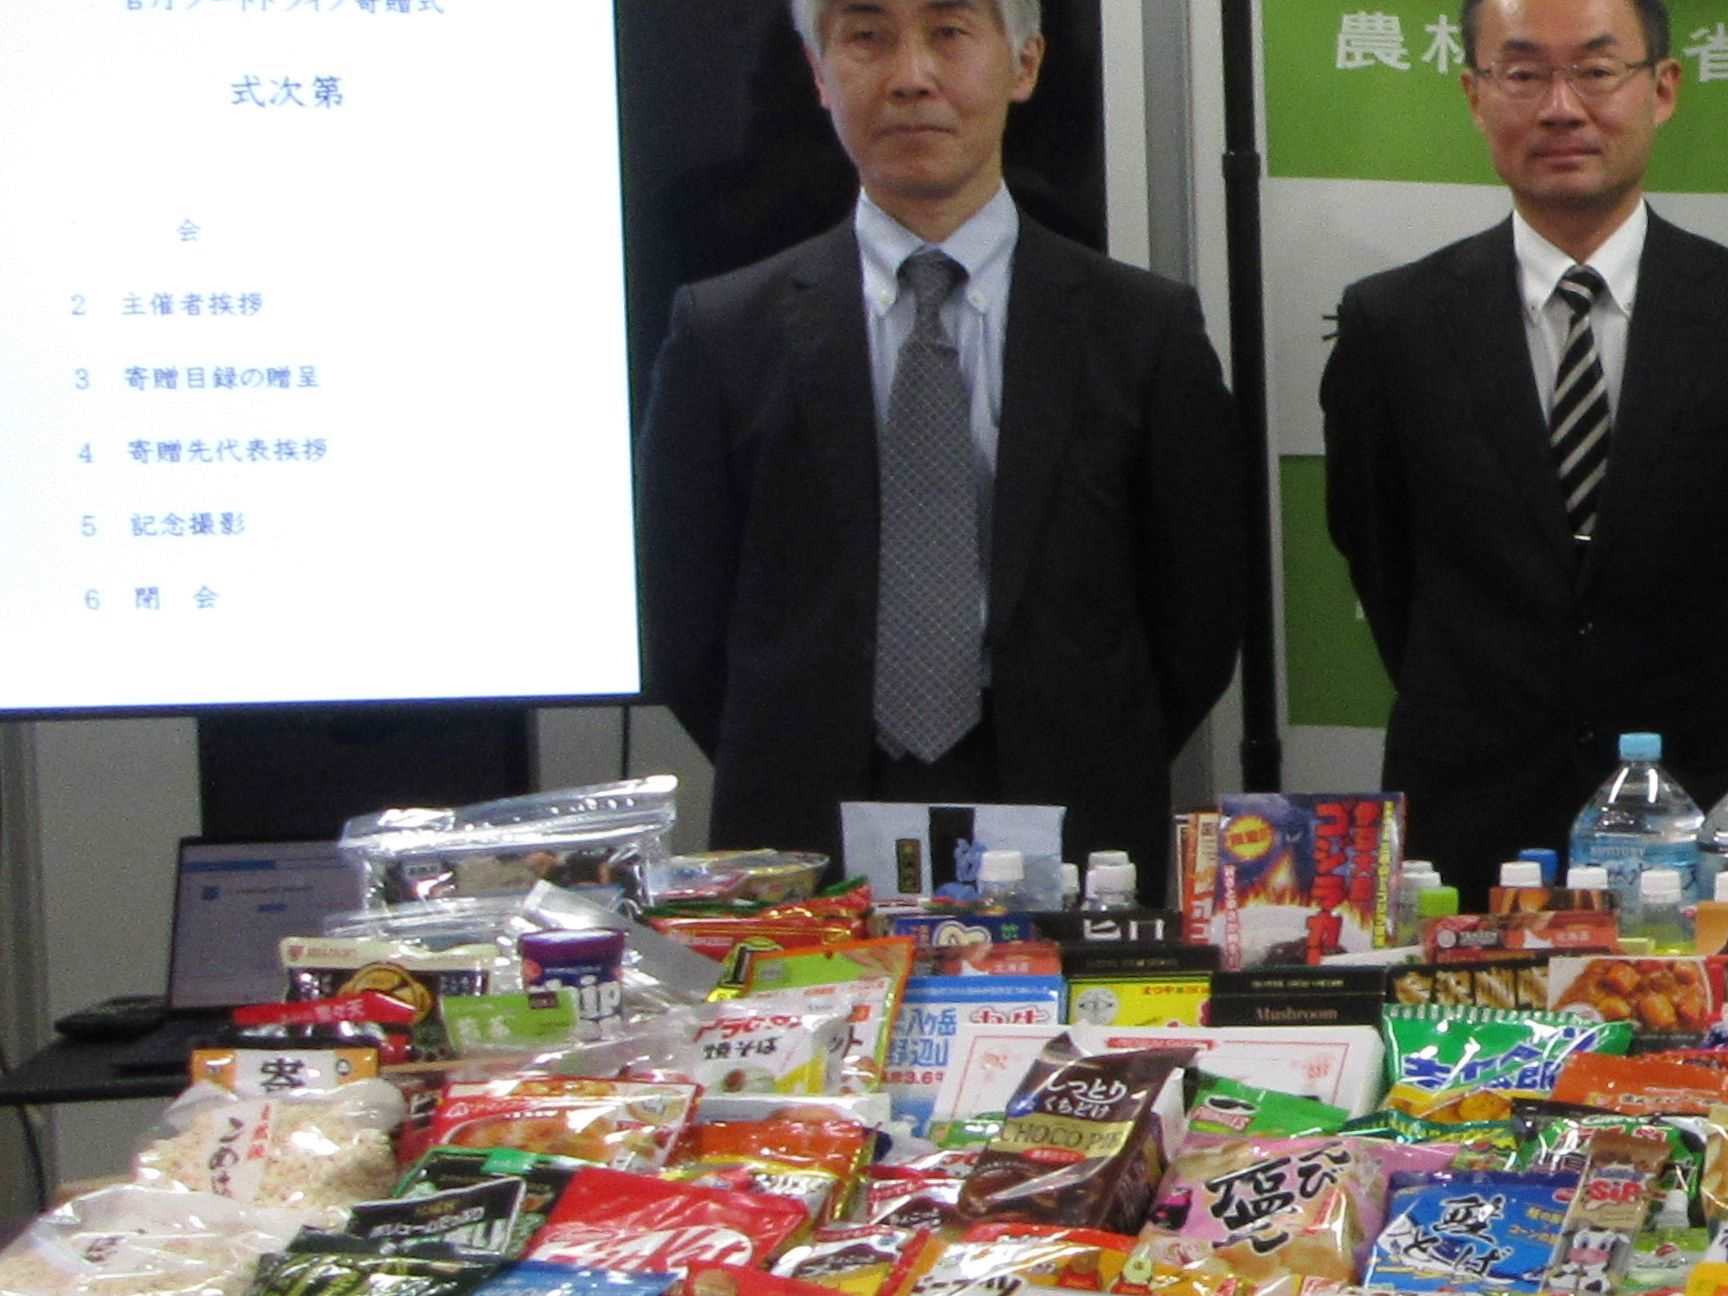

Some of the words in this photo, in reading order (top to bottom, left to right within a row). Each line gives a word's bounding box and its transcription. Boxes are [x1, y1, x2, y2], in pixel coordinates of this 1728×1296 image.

[230, 74, 345, 110] 式次第
[71, 294, 87, 317] 2
[121, 291, 265, 319] 主催者挨拶
[75, 369, 91, 392] 3
[124, 365, 321, 392] 寄贈目録の贈呈
[78, 443, 95, 464] 4
[128, 438, 329, 466] 寄贈先代表挨拶
[81, 516, 98, 538] 5
[130, 512, 247, 539] 記念撮影
[84, 590, 101, 611] 6
[1047, 1077, 1129, 1105] しっとり
